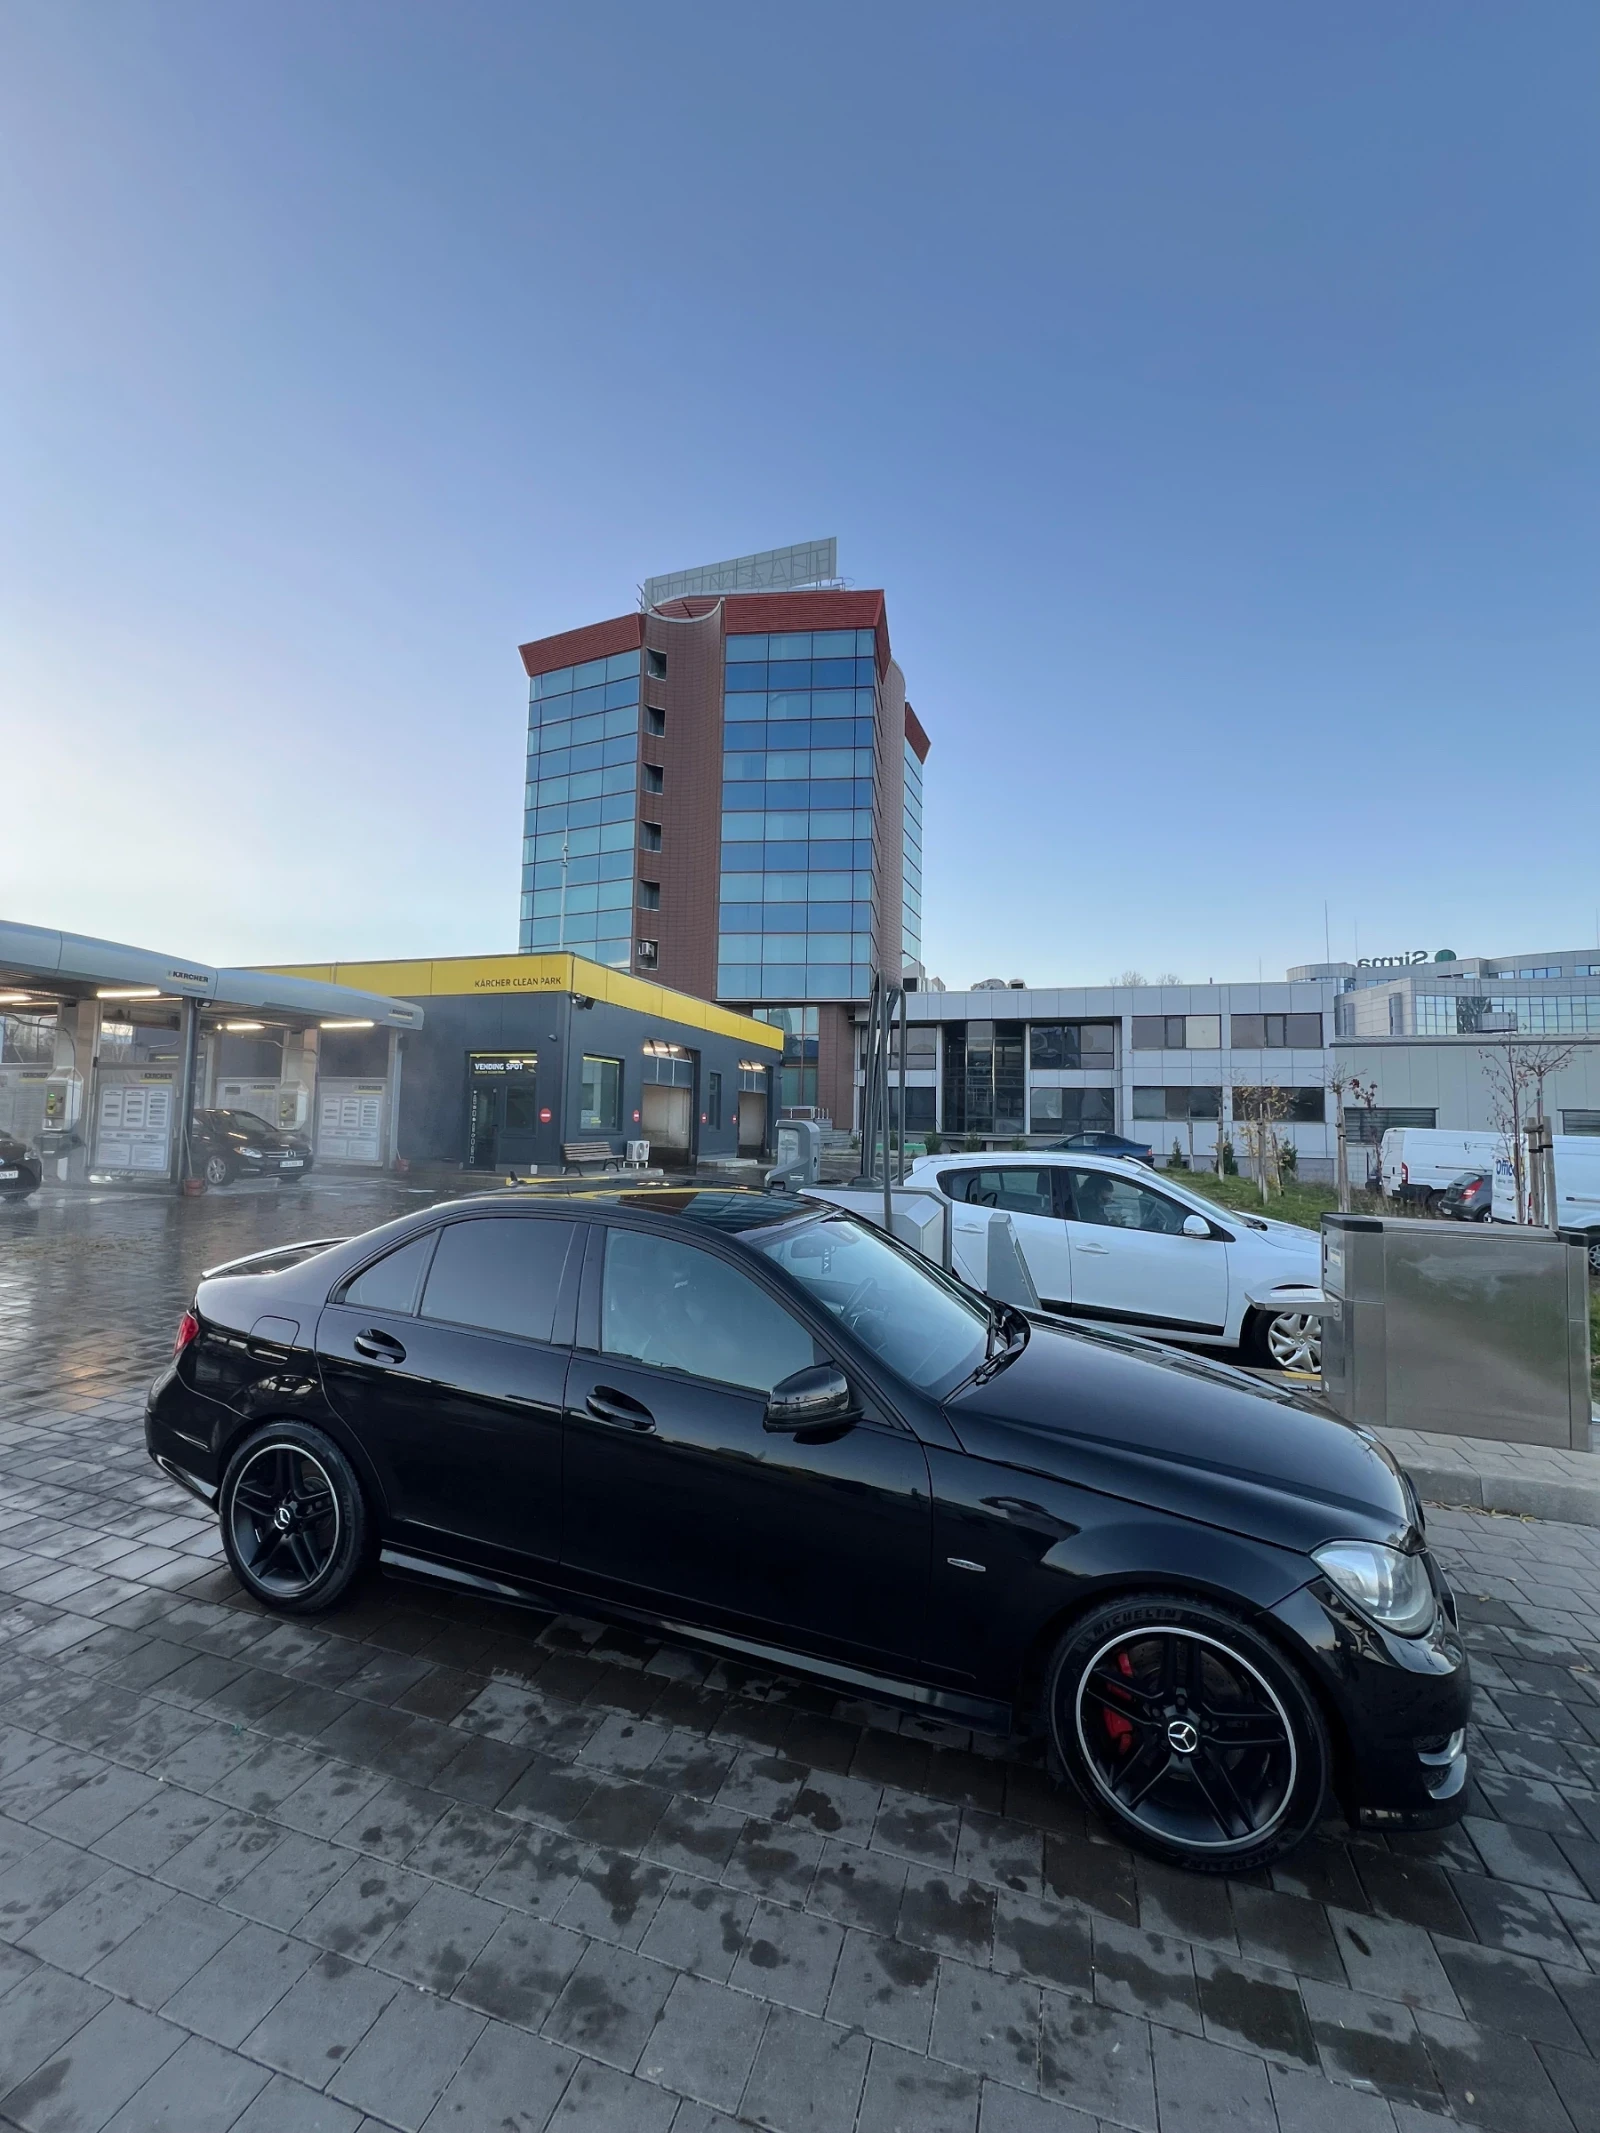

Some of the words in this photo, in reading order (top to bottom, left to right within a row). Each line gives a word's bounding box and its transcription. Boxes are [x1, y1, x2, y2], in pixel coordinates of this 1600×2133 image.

[513, 978, 538, 986] CLEAN
[541, 977, 561, 985] PARK
[1093, 1608, 1177, 1637] MICHELIN
